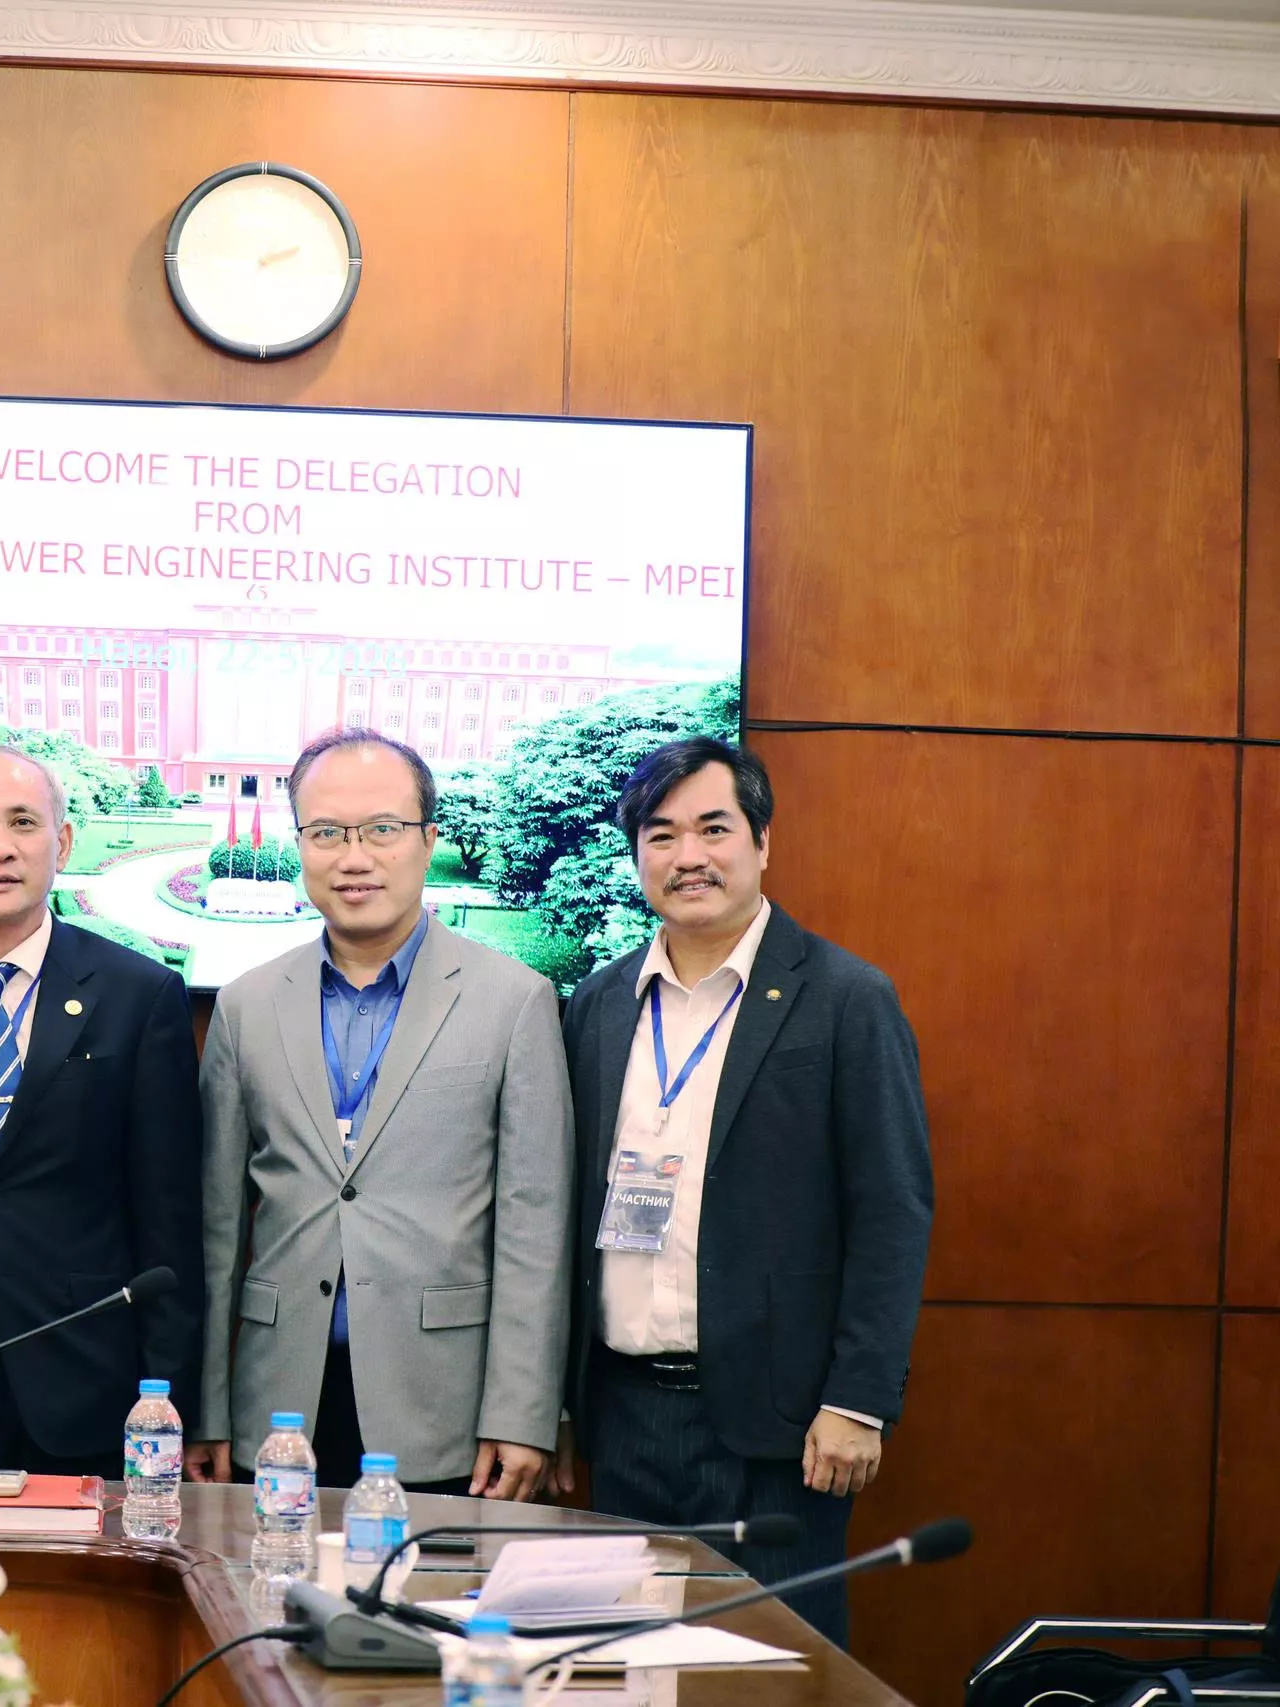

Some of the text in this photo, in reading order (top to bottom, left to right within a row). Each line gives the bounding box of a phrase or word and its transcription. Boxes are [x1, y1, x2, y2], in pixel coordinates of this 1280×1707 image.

[184, 456, 261, 491] THE
[276, 459, 522, 499] DELEGATION
[195, 501, 303, 536] FROM
[104, 545, 372, 585] ENGINEERING
[388, 554, 594, 593] INSTITUTE
[646, 564, 737, 599] MPEI
[611, 1192, 671, 1208] УЧАСТНИК
